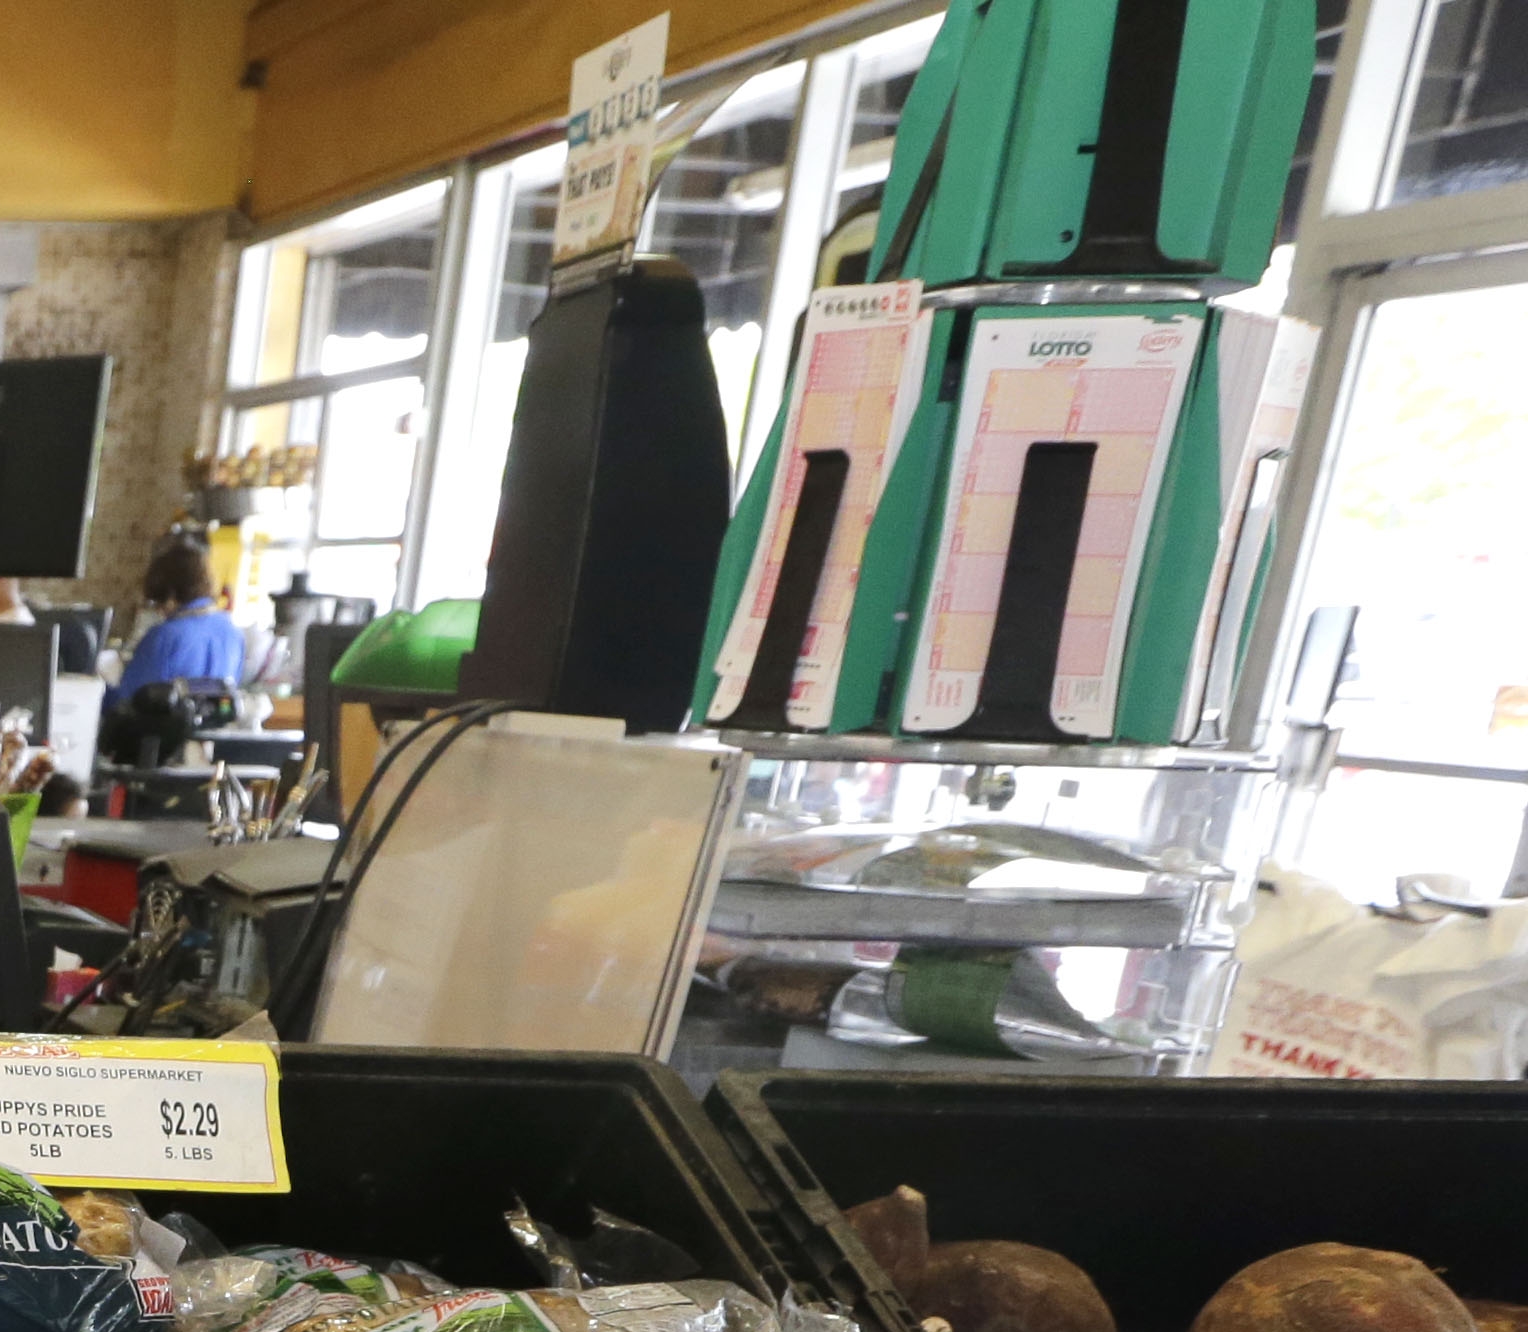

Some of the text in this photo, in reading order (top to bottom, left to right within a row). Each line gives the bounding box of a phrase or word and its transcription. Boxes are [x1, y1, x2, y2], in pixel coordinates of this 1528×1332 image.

[1028, 341, 1093, 356] LOTTO
[1241, 1031, 1344, 1077] THANK
[4, 1065, 204, 1083] NUEVO SIGLO SUPERMARKET
[53, 1103, 107, 1119] PRIDE
[160, 1098, 220, 1139] $2.29
[17, 1121, 114, 1140] POTATOES
[30, 1143, 62, 1158] 5LB
[164, 1146, 214, 1161] 5. LBS
